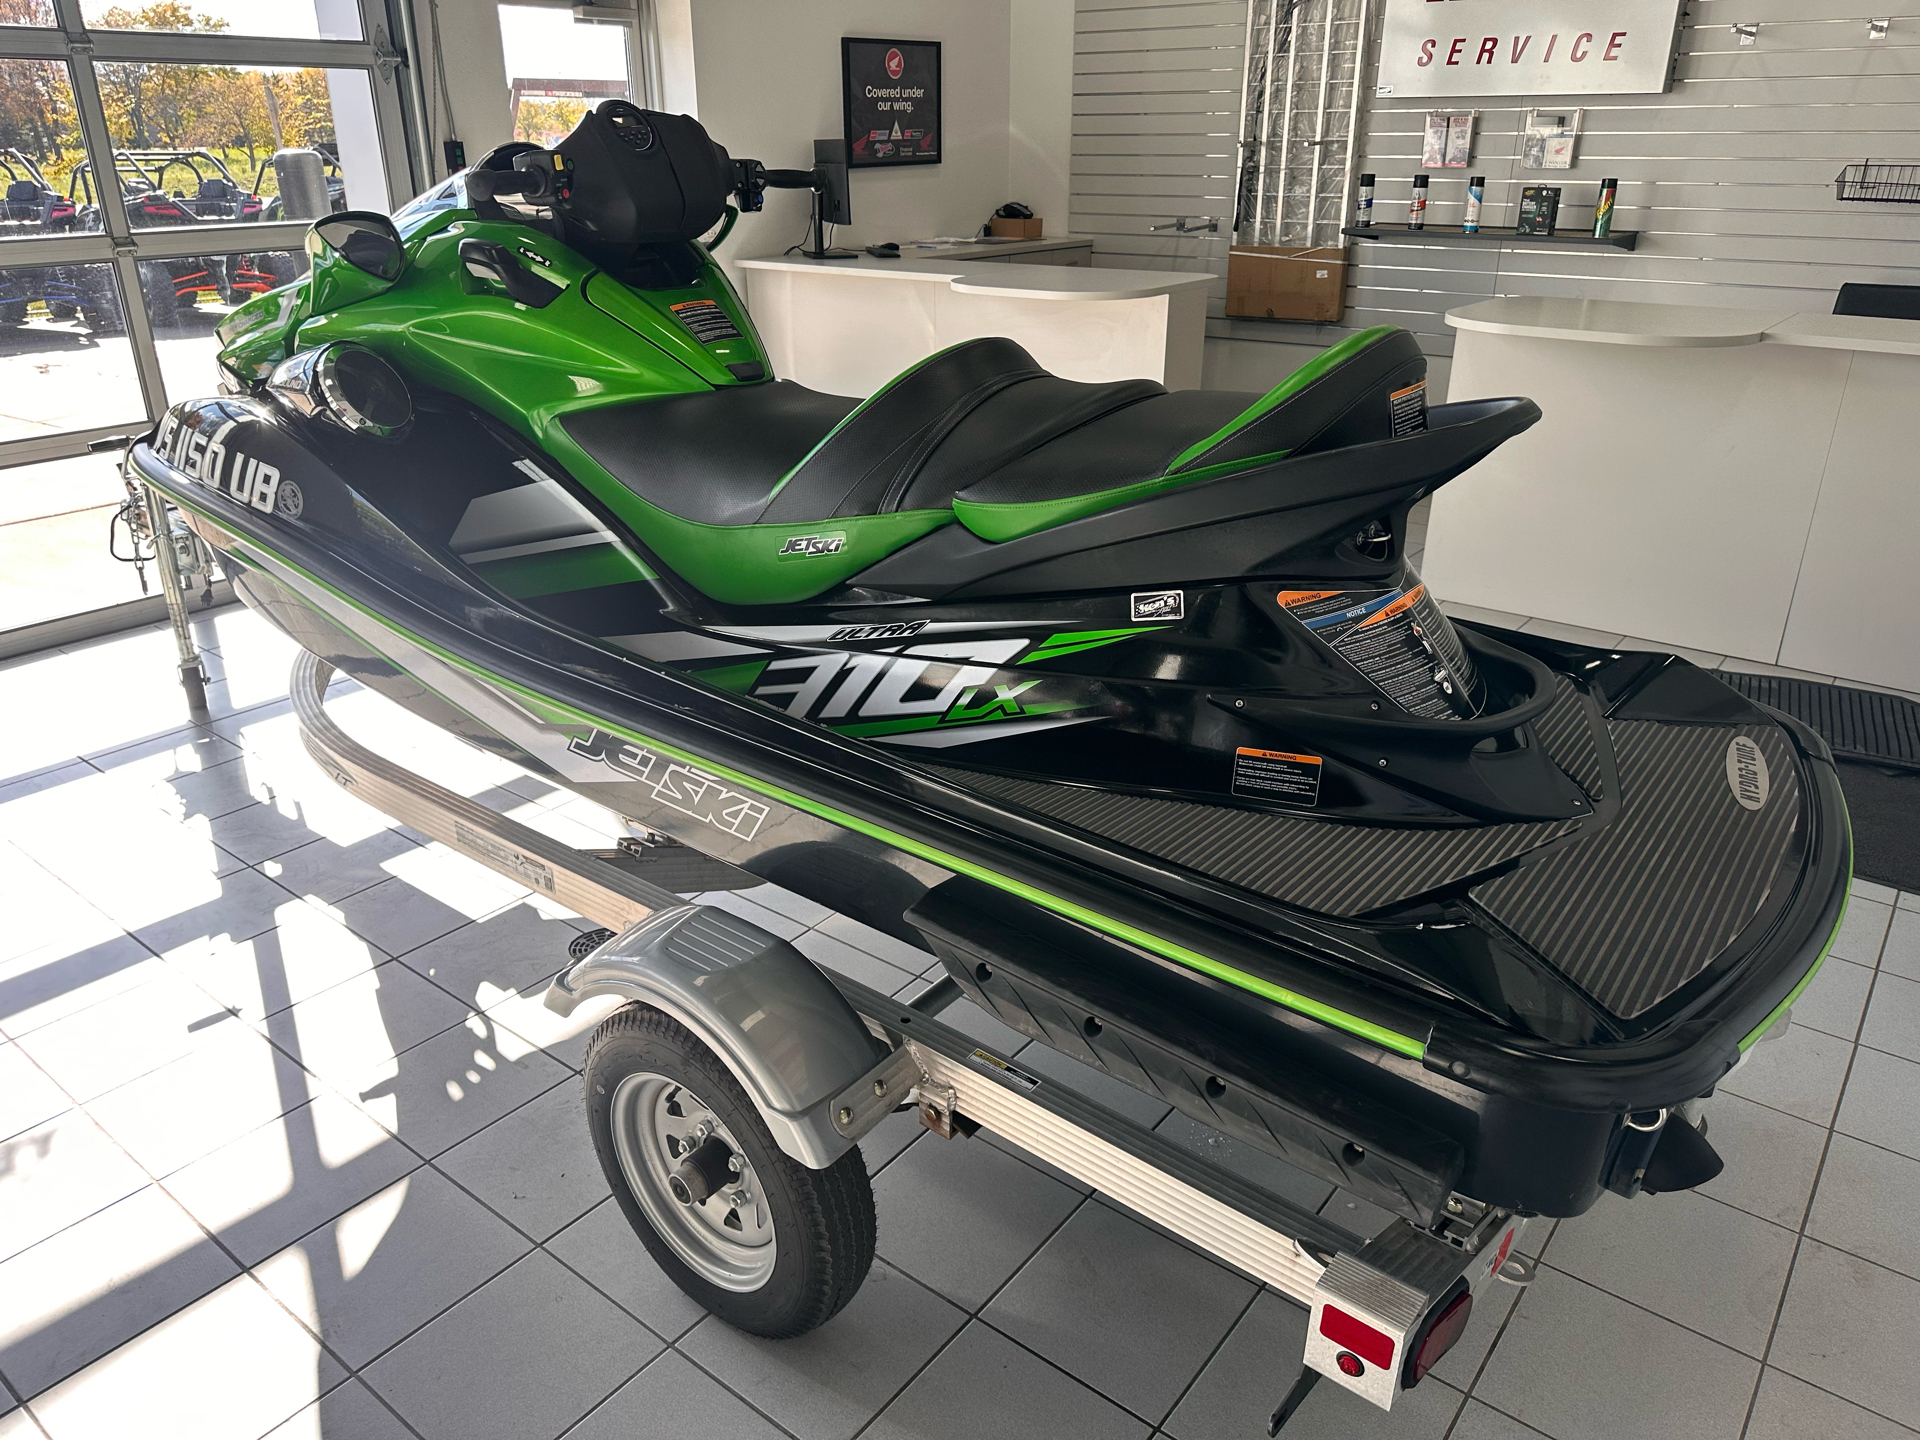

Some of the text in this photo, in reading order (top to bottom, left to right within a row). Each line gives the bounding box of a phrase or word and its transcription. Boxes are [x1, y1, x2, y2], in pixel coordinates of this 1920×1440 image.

[1417, 31, 1627, 67] SERVICE
[865, 85, 925, 98] Covered under
[877, 99, 914, 113] our wing.
[230, 451, 281, 514] UB
[1290, 592, 1322, 605] WARNING
[1346, 607, 1367, 619] NOTICE
[1389, 602, 1408, 615] WARNING
[827, 619, 932, 642] ULTRA
[1269, 752, 1297, 761] WARNING
[1735, 741, 1761, 804] HYDRO-TURF
